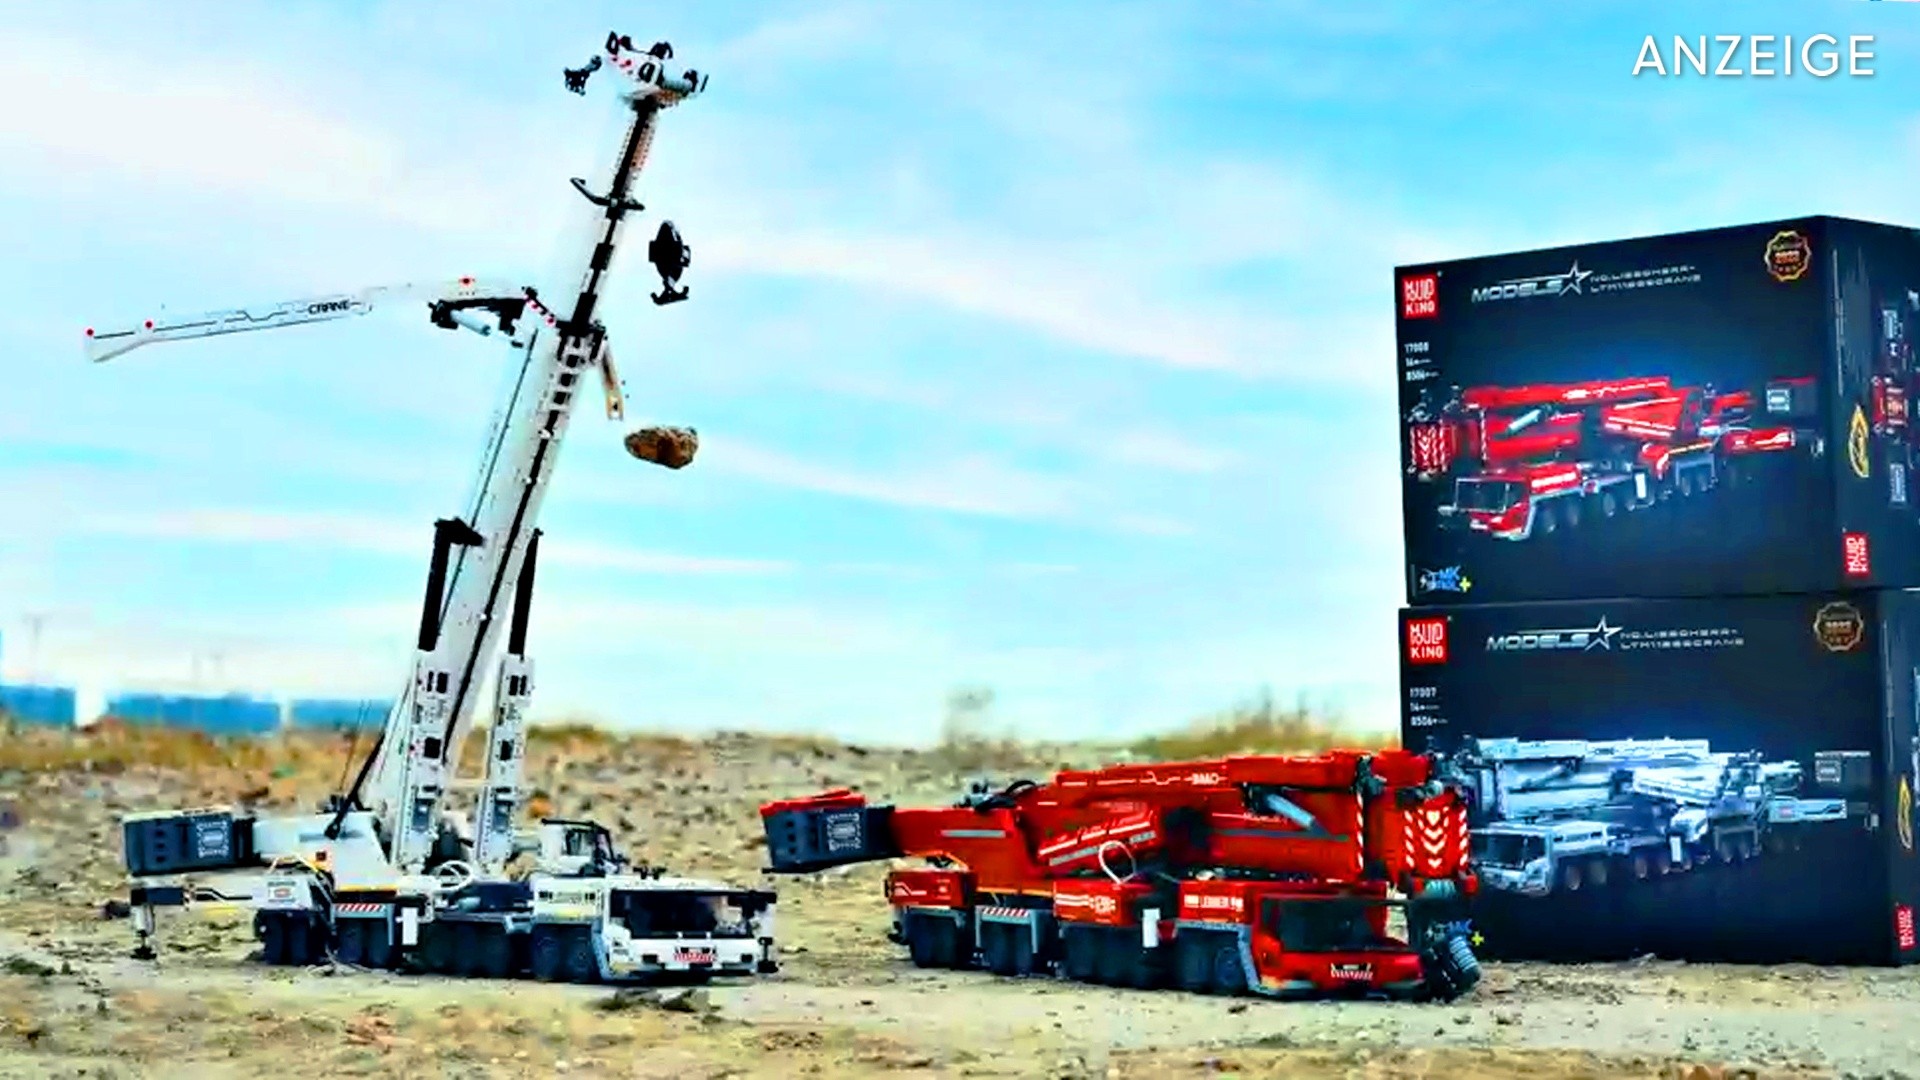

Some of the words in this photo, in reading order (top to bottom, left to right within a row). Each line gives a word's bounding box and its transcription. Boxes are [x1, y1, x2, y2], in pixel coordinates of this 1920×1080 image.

[1471, 279, 1563, 303] MODELS
[1405, 301, 1435, 315] KING
[1485, 632, 1590, 651] MODELS
[1410, 645, 1444, 659] KING
